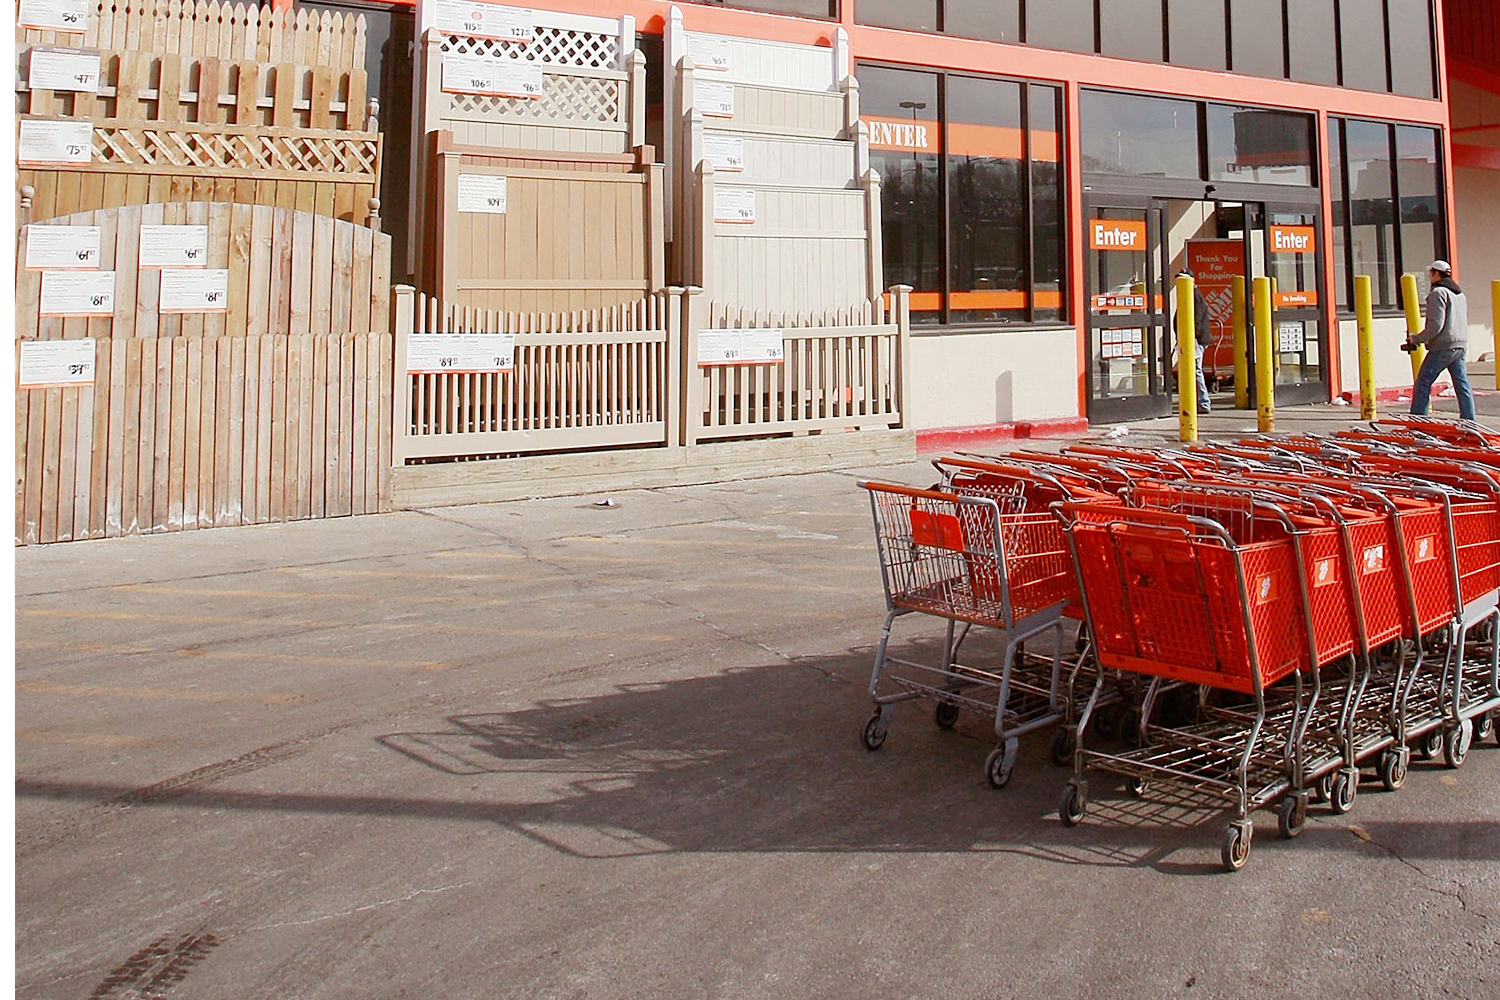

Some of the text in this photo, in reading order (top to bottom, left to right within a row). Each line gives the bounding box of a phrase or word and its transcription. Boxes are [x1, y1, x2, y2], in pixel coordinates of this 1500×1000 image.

[869, 121, 928, 148] ENTER
[1095, 225, 1137, 246] Enter
[1274, 230, 1309, 249] Enter
[1195, 254, 1238, 263] Thank You
